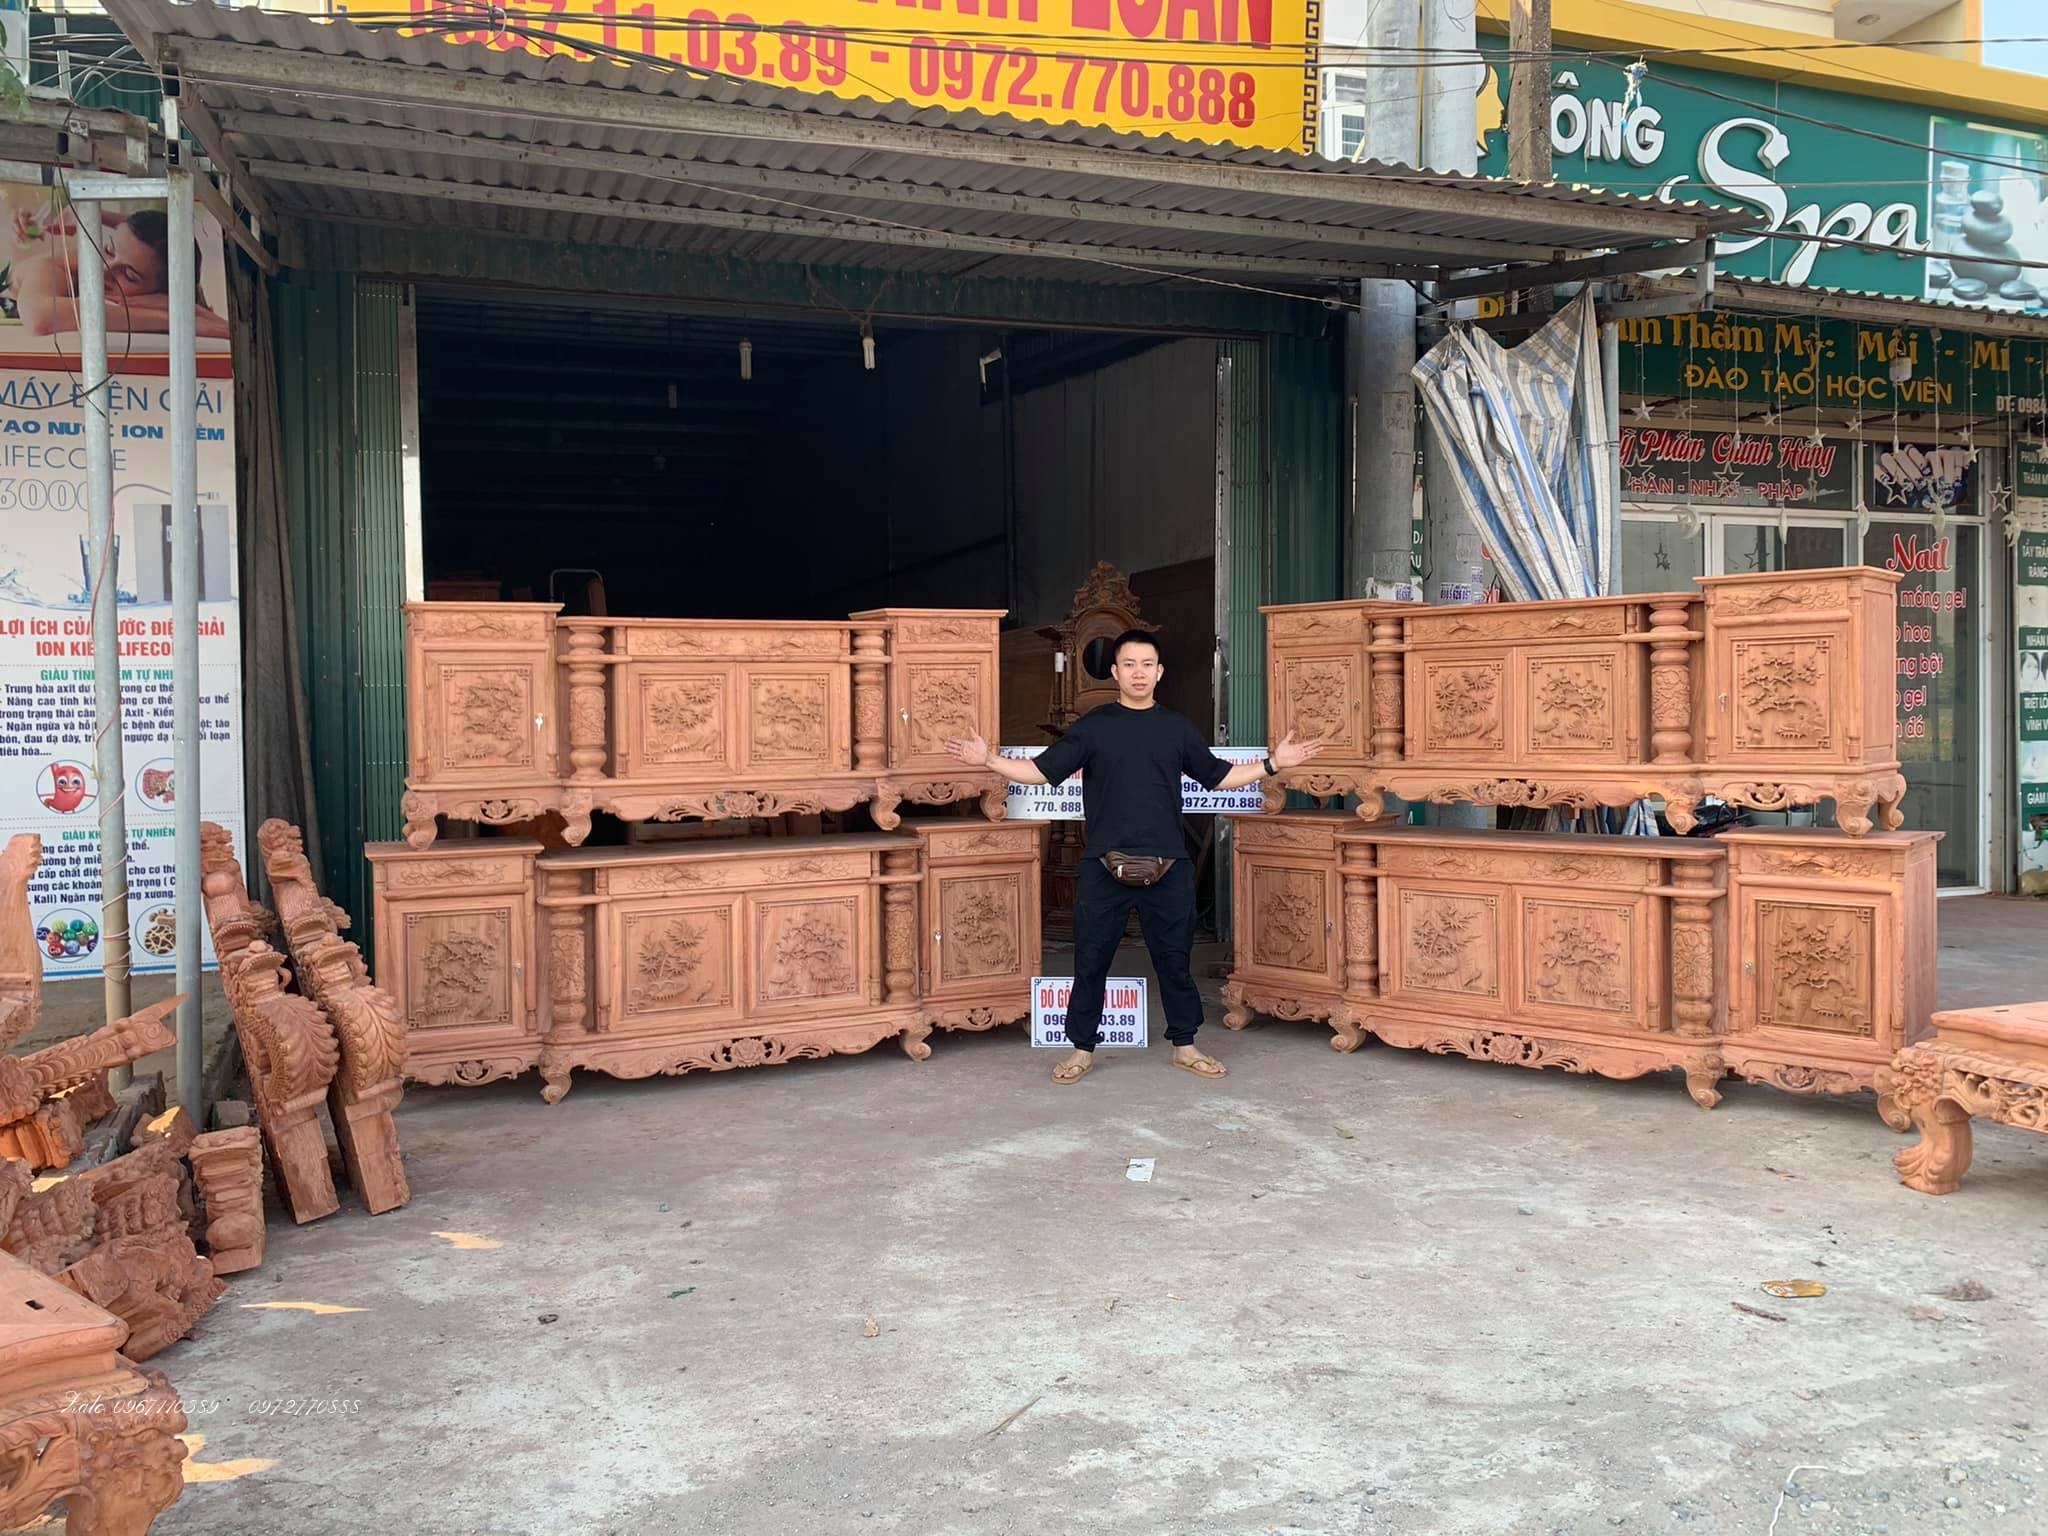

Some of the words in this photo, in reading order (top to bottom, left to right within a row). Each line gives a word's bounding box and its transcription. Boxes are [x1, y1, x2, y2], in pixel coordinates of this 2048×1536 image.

[909, 36, 1255, 128] 0972.770.888
[1551, 70, 1665, 168] ÔNG
[1655, 117, 1931, 287] Spa
[1684, 357, 1749, 391] ĐÀO
[1761, 368, 1818, 400] TẠO
[1826, 374, 1887, 405] HỌC
[1901, 376, 1953, 405] VIÊN
[159, 382, 222, 414] GẢI
[0, 419, 41, 436] ẠO
[121, 424, 164, 439] ION
[1713, 431, 1774, 466] Chính
[1630, 473, 1674, 496] HÀN
[1757, 479, 1804, 501] PHÁP
[1886, 533, 1952, 574] Nail
[1901, 584, 1944, 613] móng
[1945, 587, 1968, 613] gel
[0, 617, 25, 639] LỢI
[30, 616, 58, 636] ÍCH
[117, 617, 146, 637] ƯỚC
[151, 618, 174, 640] ĐIỆ
[1903, 621, 1932, 642] hoa
[36, 641, 65, 656] ION
[117, 641, 174, 656] LIFECO
[40, 666, 68, 681] GIÀU
[72, 667, 95, 681] TÍN
[1919, 653, 1943, 679] bột
[5, 684, 33, 694] Trung
[57, 684, 76, 694] axit
[120, 685, 141, 694] rong
[1903, 685, 1927, 711] gel
[37, 697, 56, 706] cao
[27, 709, 53, 720] trạng
[125, 708, 144, 717] Axit
[64, 722, 75, 730] và
[1906, 714, 1926, 738] đá
[24, 734, 42, 743] đau
[1008, 785, 1064, 796] 967.11.03
[1181, 797, 1263, 808] 972.770.888
[62, 829, 86, 841] GIÀU
[128, 865, 146, 875] cho
[72, 880, 102, 890] khoán
[1111, 985, 1138, 1009] LUÂN
